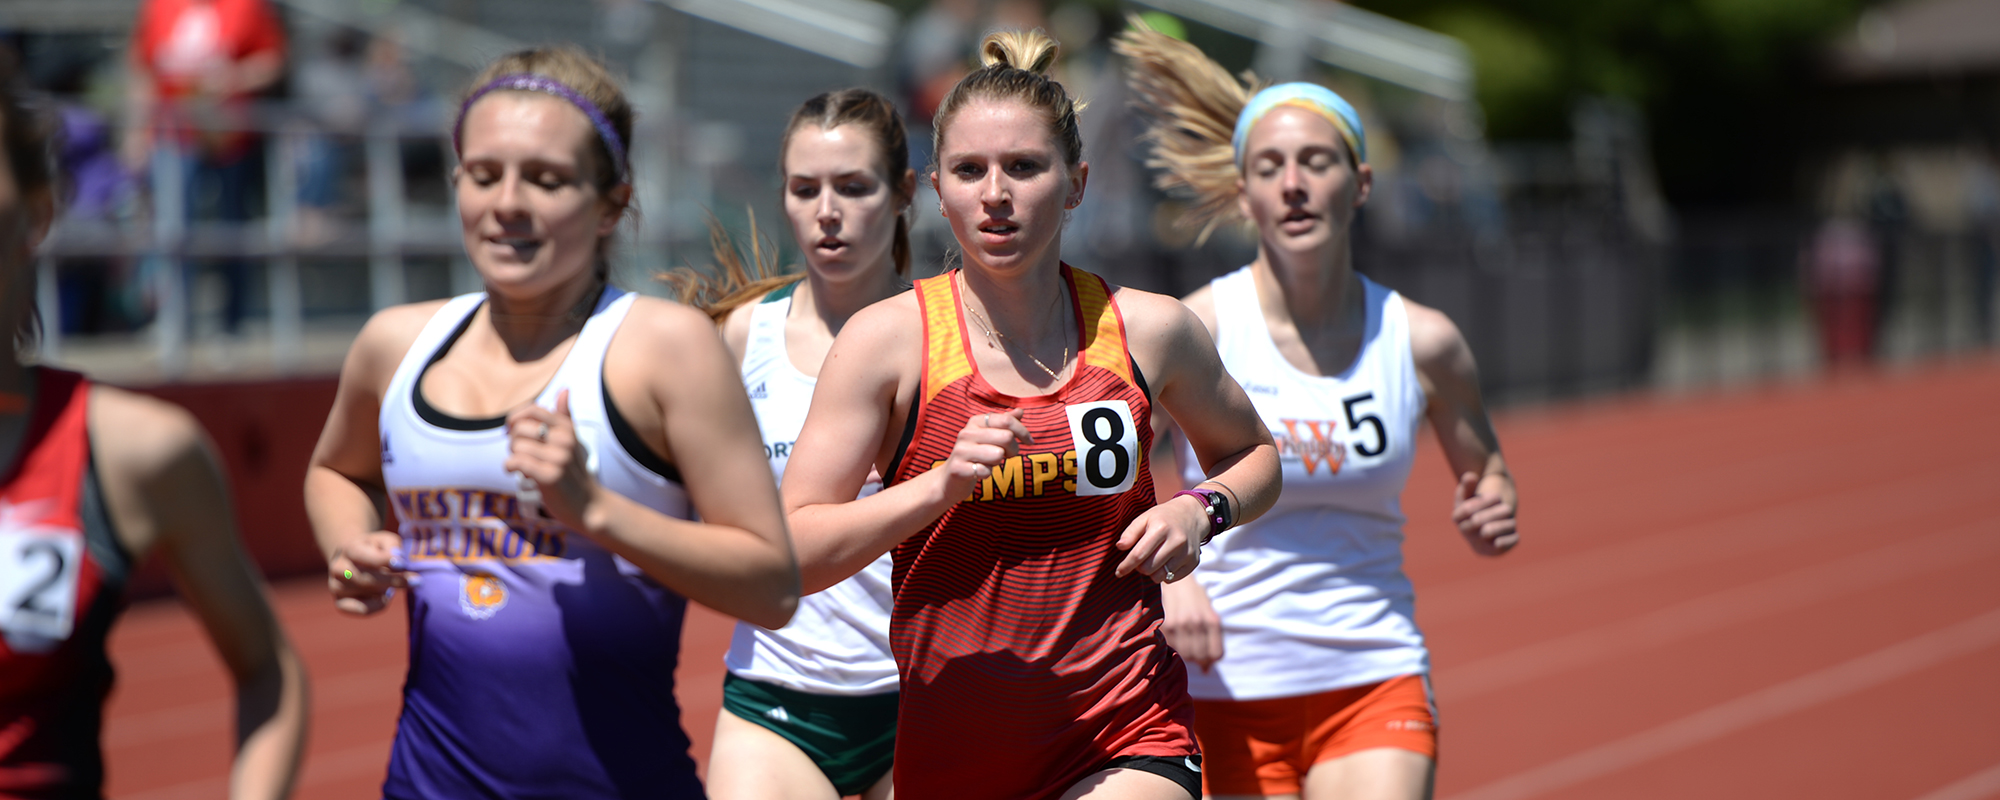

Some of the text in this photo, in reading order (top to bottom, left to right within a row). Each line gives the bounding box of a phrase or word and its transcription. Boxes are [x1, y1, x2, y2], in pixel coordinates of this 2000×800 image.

[1081, 407, 1130, 489] 8
[1342, 391, 1388, 457] 5
[18, 540, 64, 616] 2
[410, 526, 565, 563] ILLINOIS
